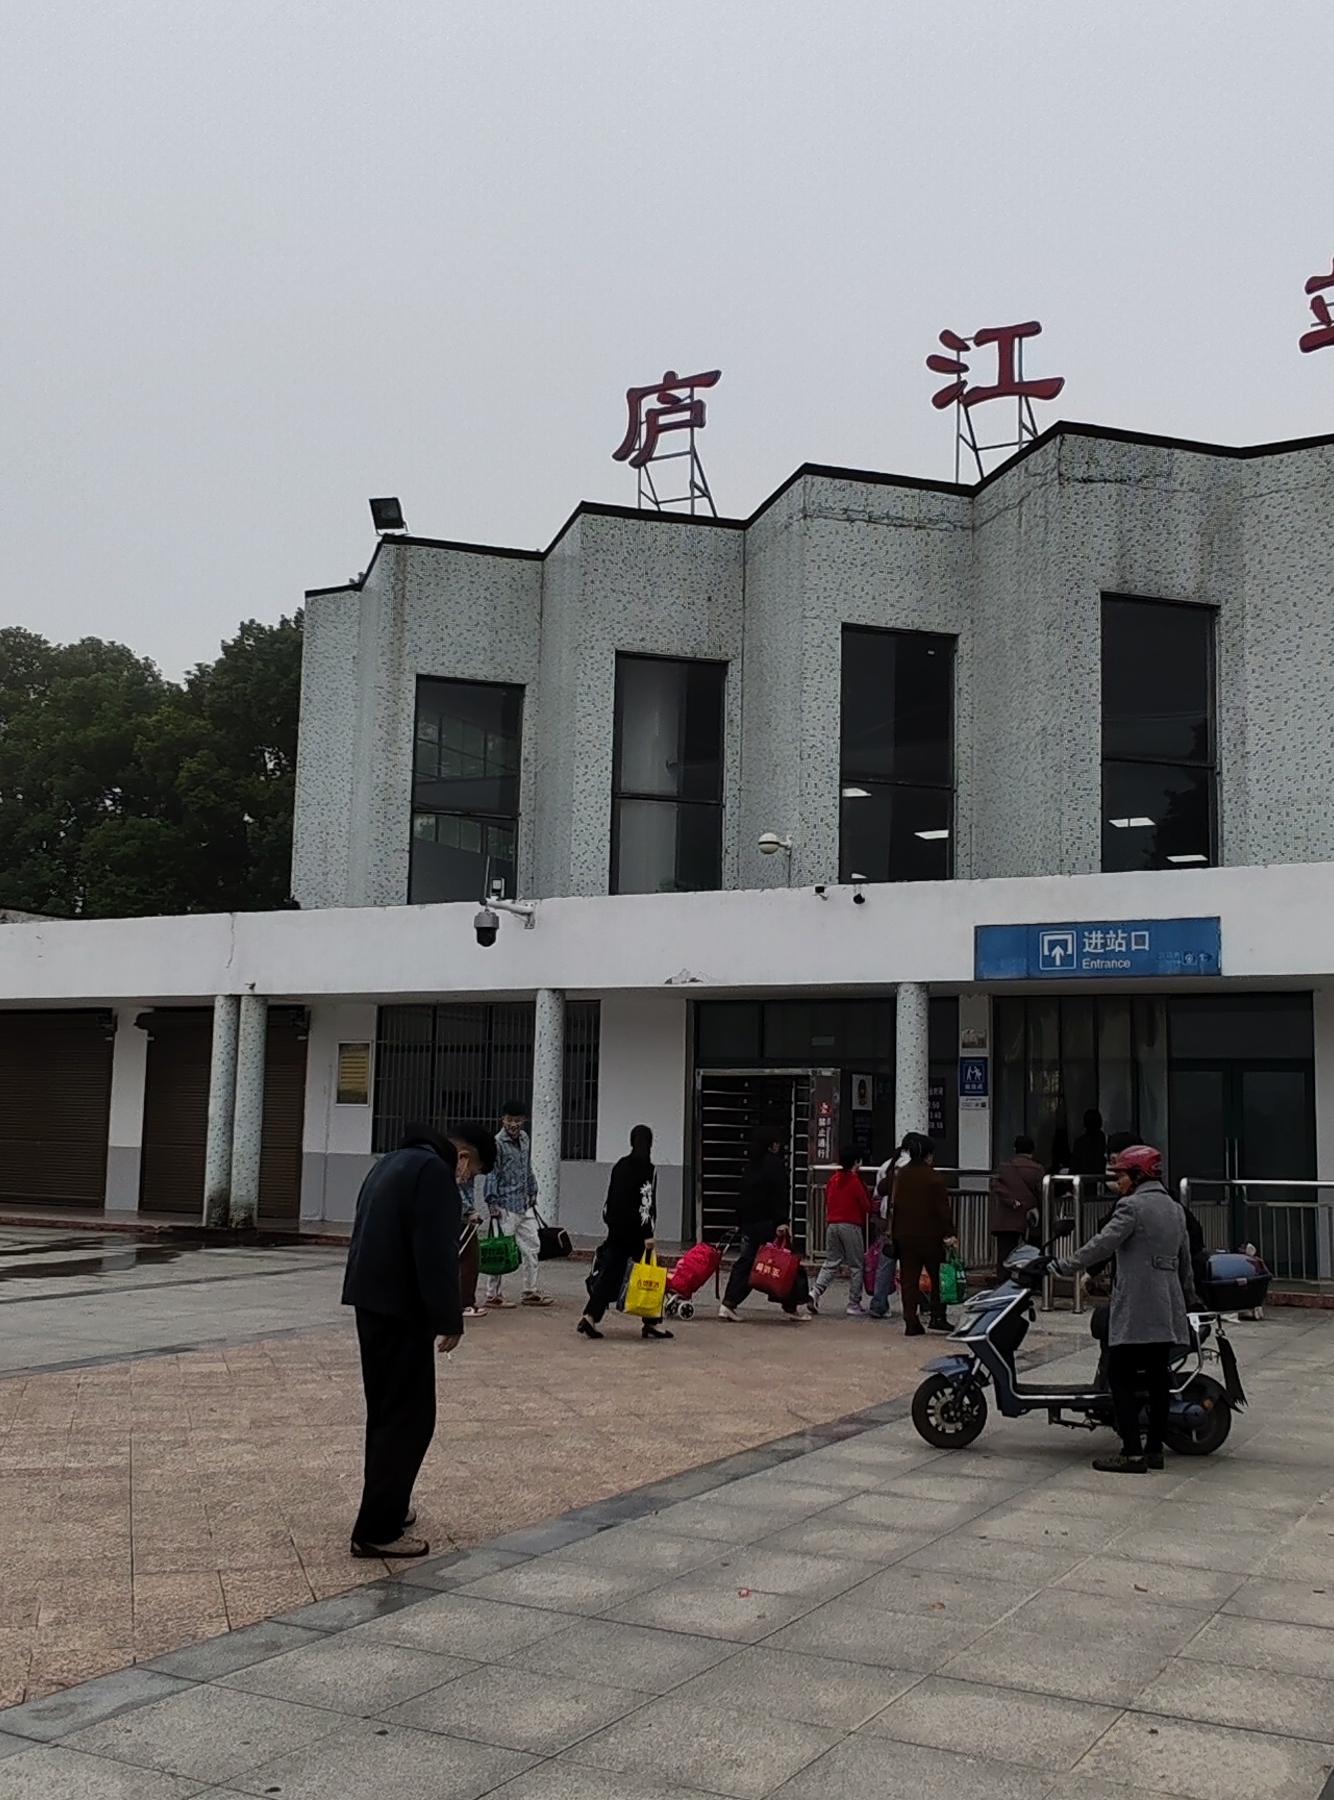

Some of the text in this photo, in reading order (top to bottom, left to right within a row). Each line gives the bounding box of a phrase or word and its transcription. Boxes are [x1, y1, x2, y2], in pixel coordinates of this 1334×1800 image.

[1082, 930, 1150, 953] 进站口
[1082, 958, 1131, 970] Entrance
